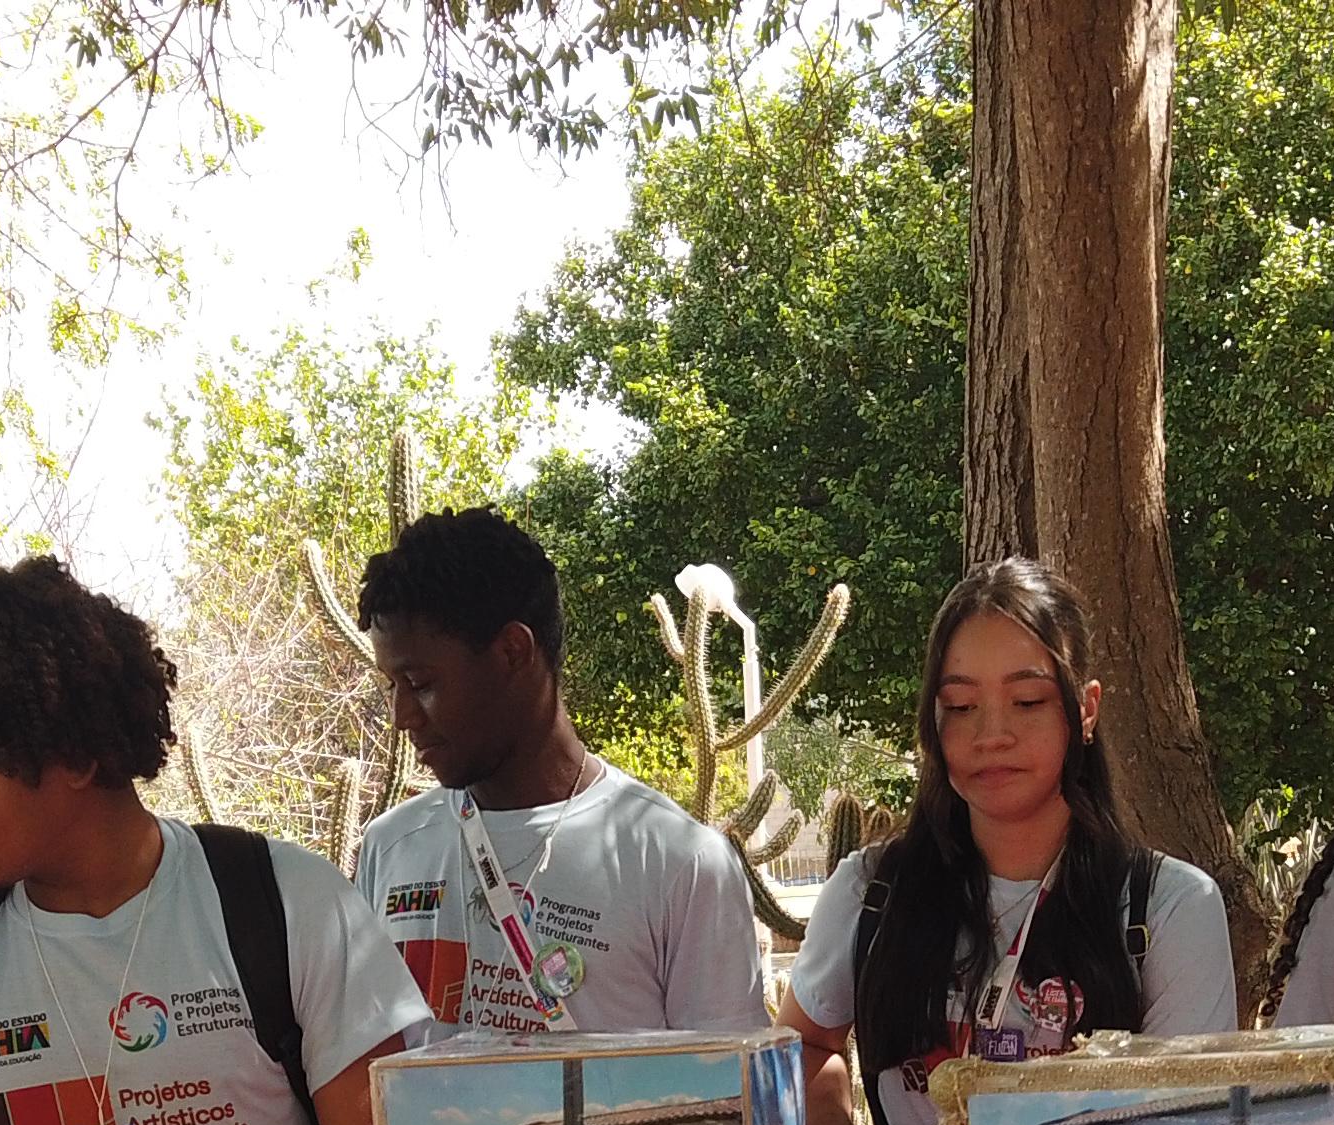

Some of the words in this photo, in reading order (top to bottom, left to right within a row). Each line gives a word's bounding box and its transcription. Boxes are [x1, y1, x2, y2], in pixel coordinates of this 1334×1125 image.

[386, 888, 444, 916] BAHIA
[540, 897, 601, 921] Programas
[536, 911, 544, 919] e
[546, 912, 593, 933] Projetos
[535, 922, 610, 952] Estruturantes
[471, 959, 523, 984] Projet
[171, 987, 240, 1006] Programas
[468, 984, 535, 1010] Artístic
[11, 1013, 47, 1027] ESTADO
[174, 1011, 182, 1021] e
[187, 1001, 241, 1019] Projetos
[464, 1011, 473, 1024] e
[479, 1009, 549, 1033] Cultura
[119, 1080, 211, 1109] Projetos
